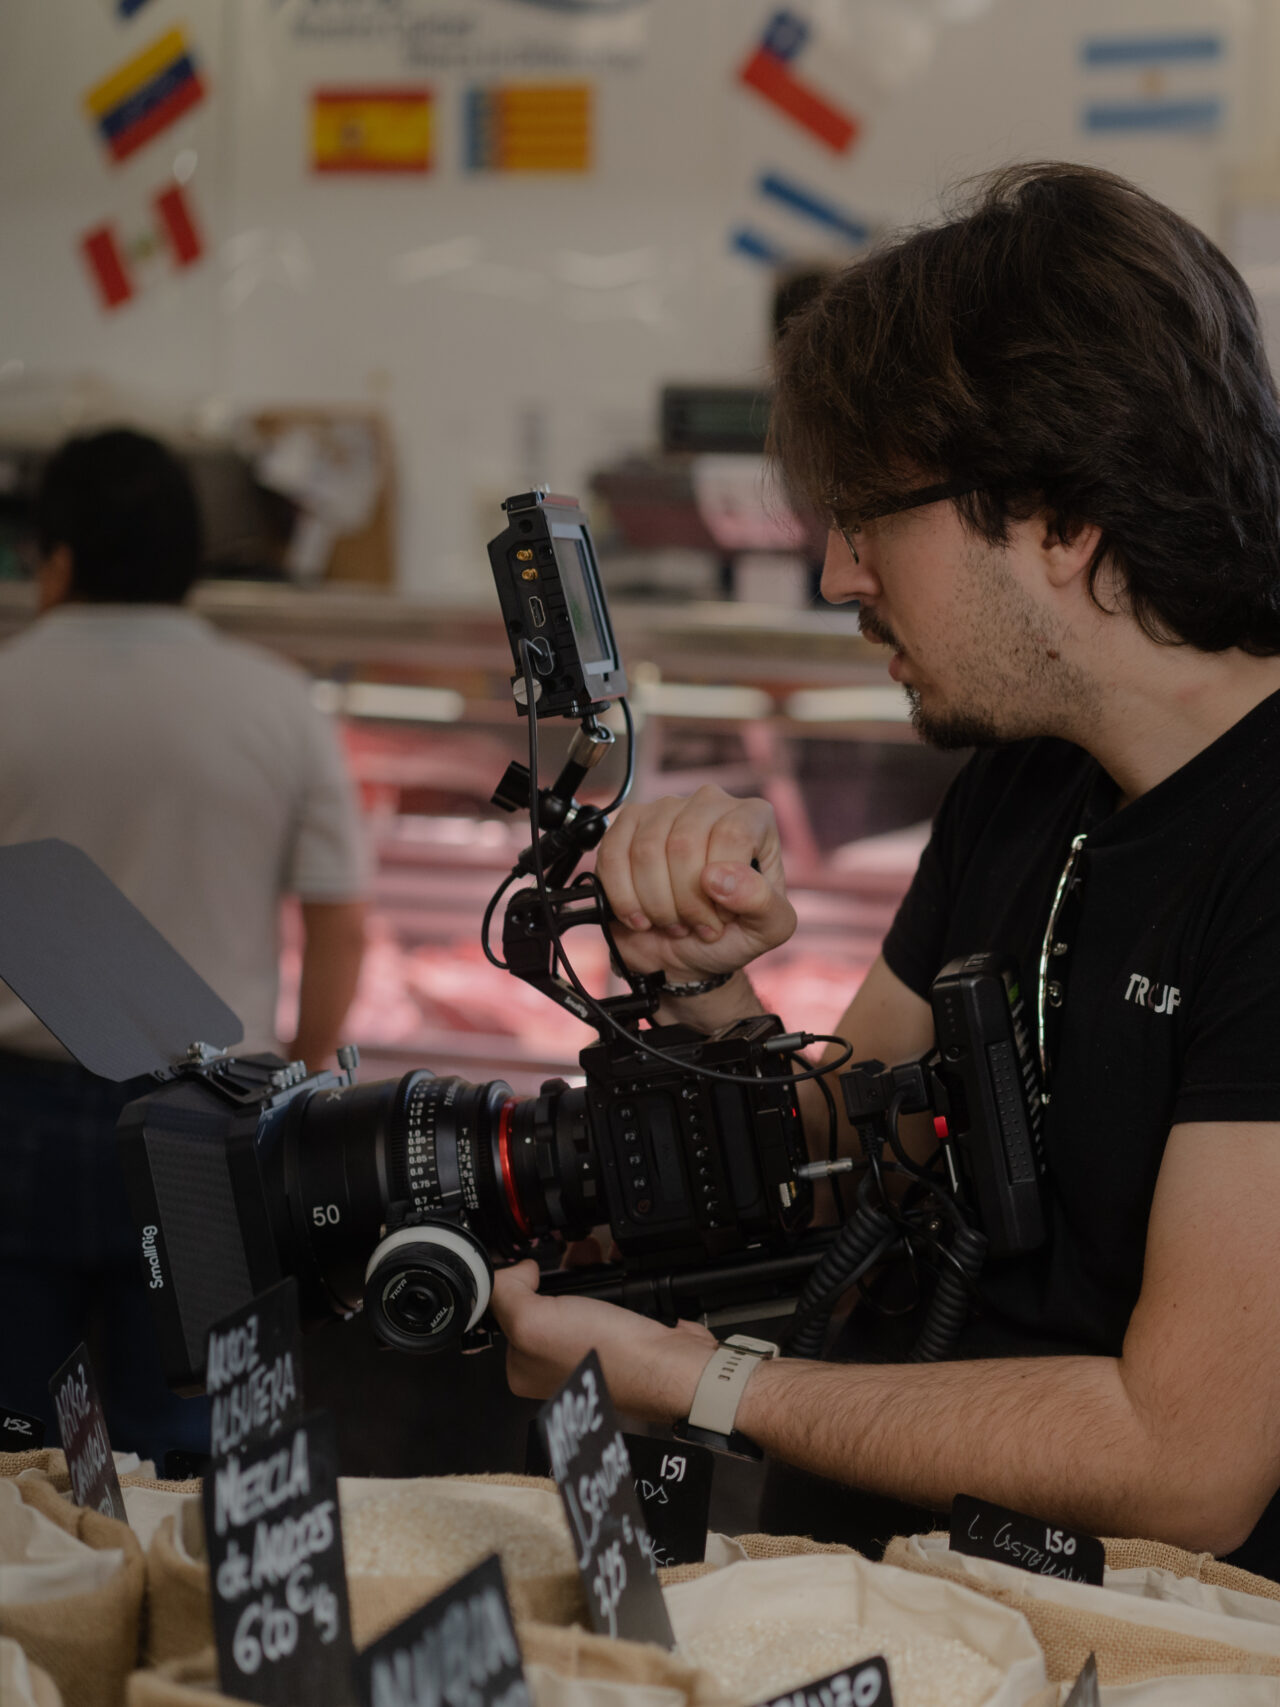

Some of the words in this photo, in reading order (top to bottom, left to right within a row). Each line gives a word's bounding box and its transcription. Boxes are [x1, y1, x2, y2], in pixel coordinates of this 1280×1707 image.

[621, 1108, 631, 1118] F1
[408, 1129, 421, 1138] 1.0
[624, 1132, 636, 1141] F2
[629, 1155, 640, 1165] F3
[411, 1180, 431, 1190] 0.75
[633, 1177, 645, 1188] F4
[414, 1196, 428, 1206] 0.7
[312, 1204, 341, 1228] 50
[141, 1225, 164, 1289] SmallRig
[3, 1416, 32, 1435] 152
[660, 1454, 687, 1482] 151
[1044, 1527, 1077, 1556] 150
